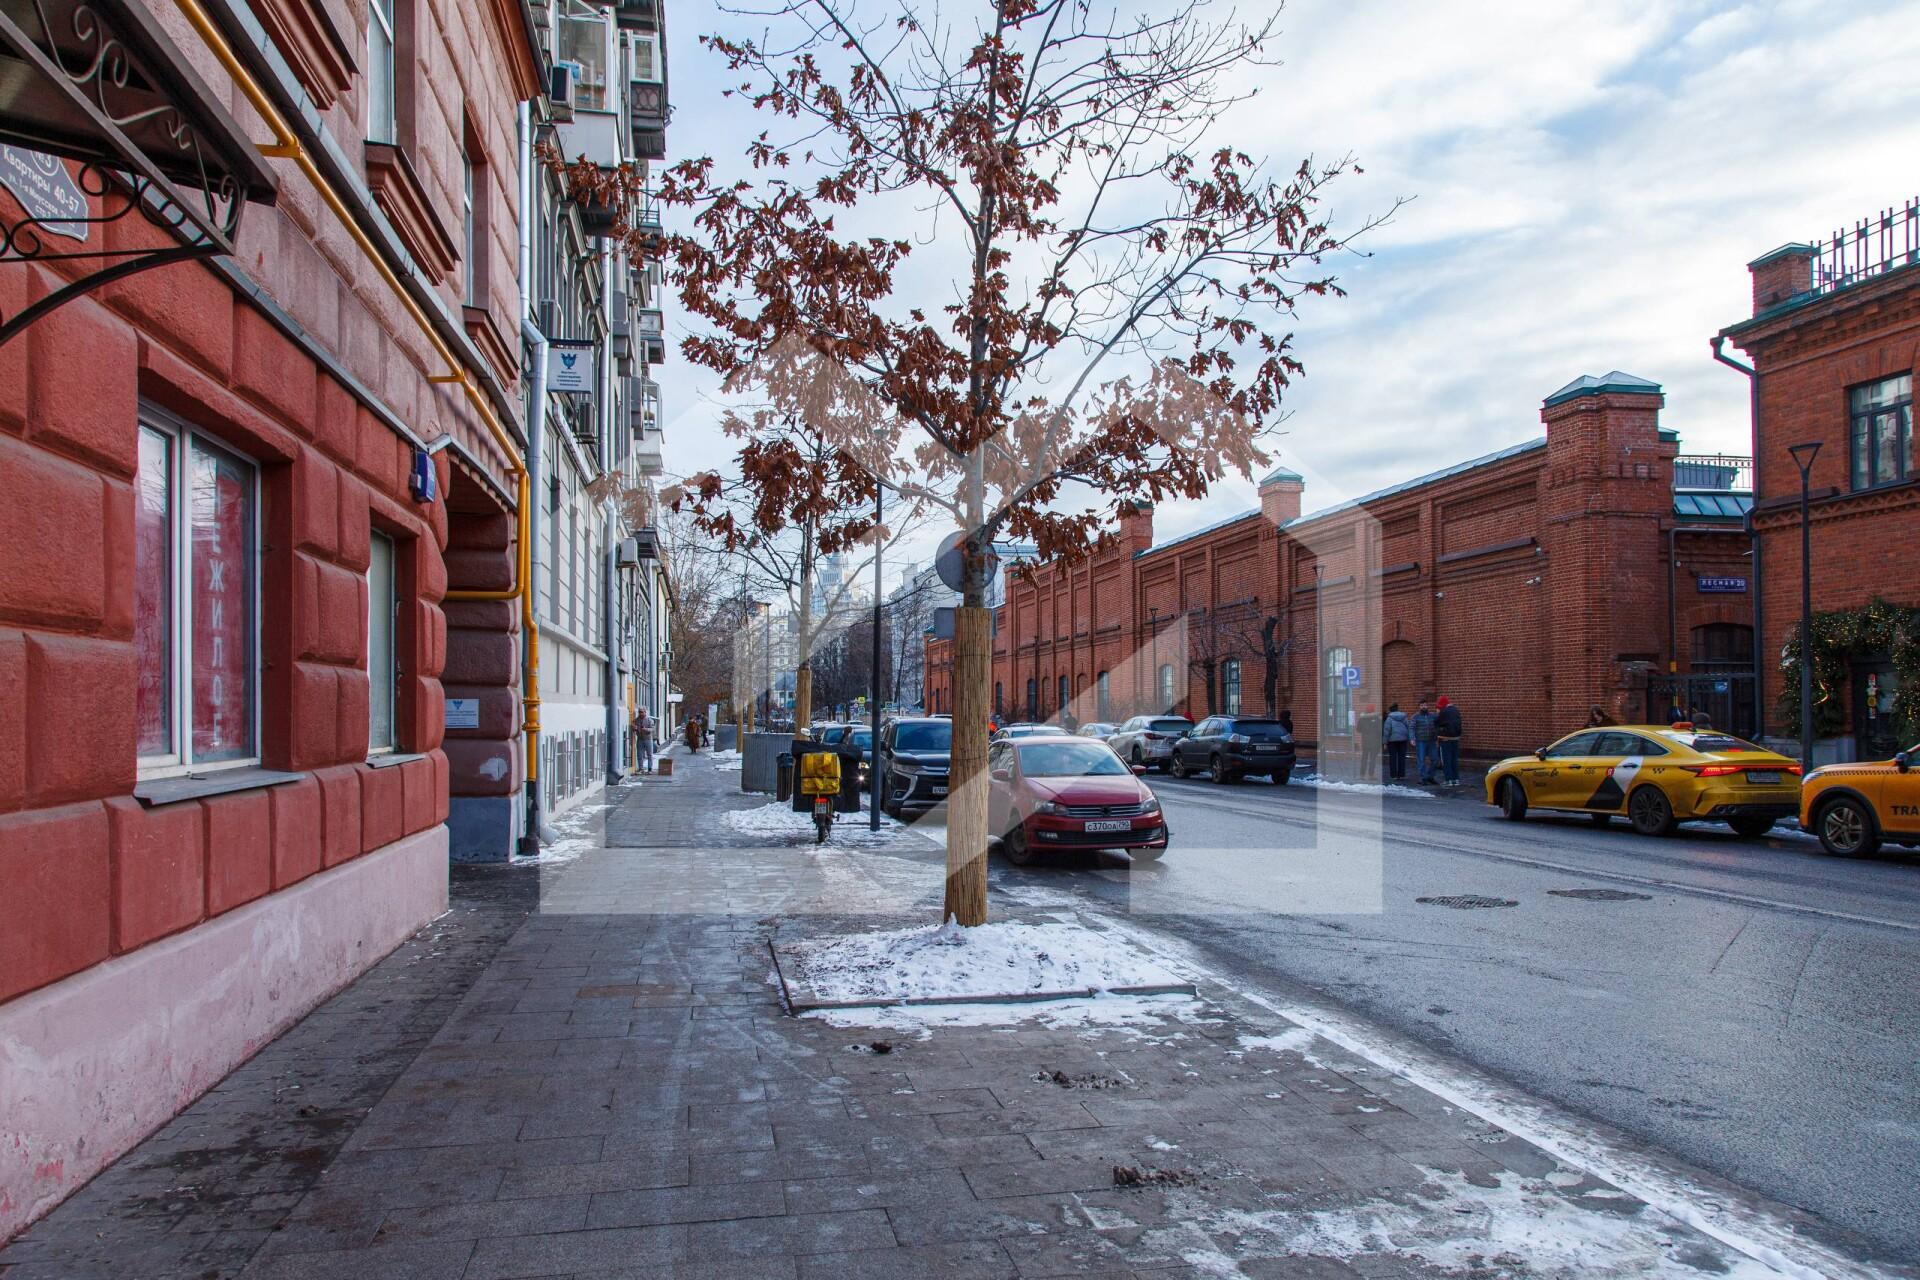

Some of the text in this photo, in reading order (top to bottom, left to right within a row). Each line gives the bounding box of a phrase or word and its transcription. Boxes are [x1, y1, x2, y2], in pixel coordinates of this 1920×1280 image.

[4, 145, 79, 213] Квартиры 40-57
[1346, 668, 1358, 686] P
[1890, 805, 1919, 816] TRA
